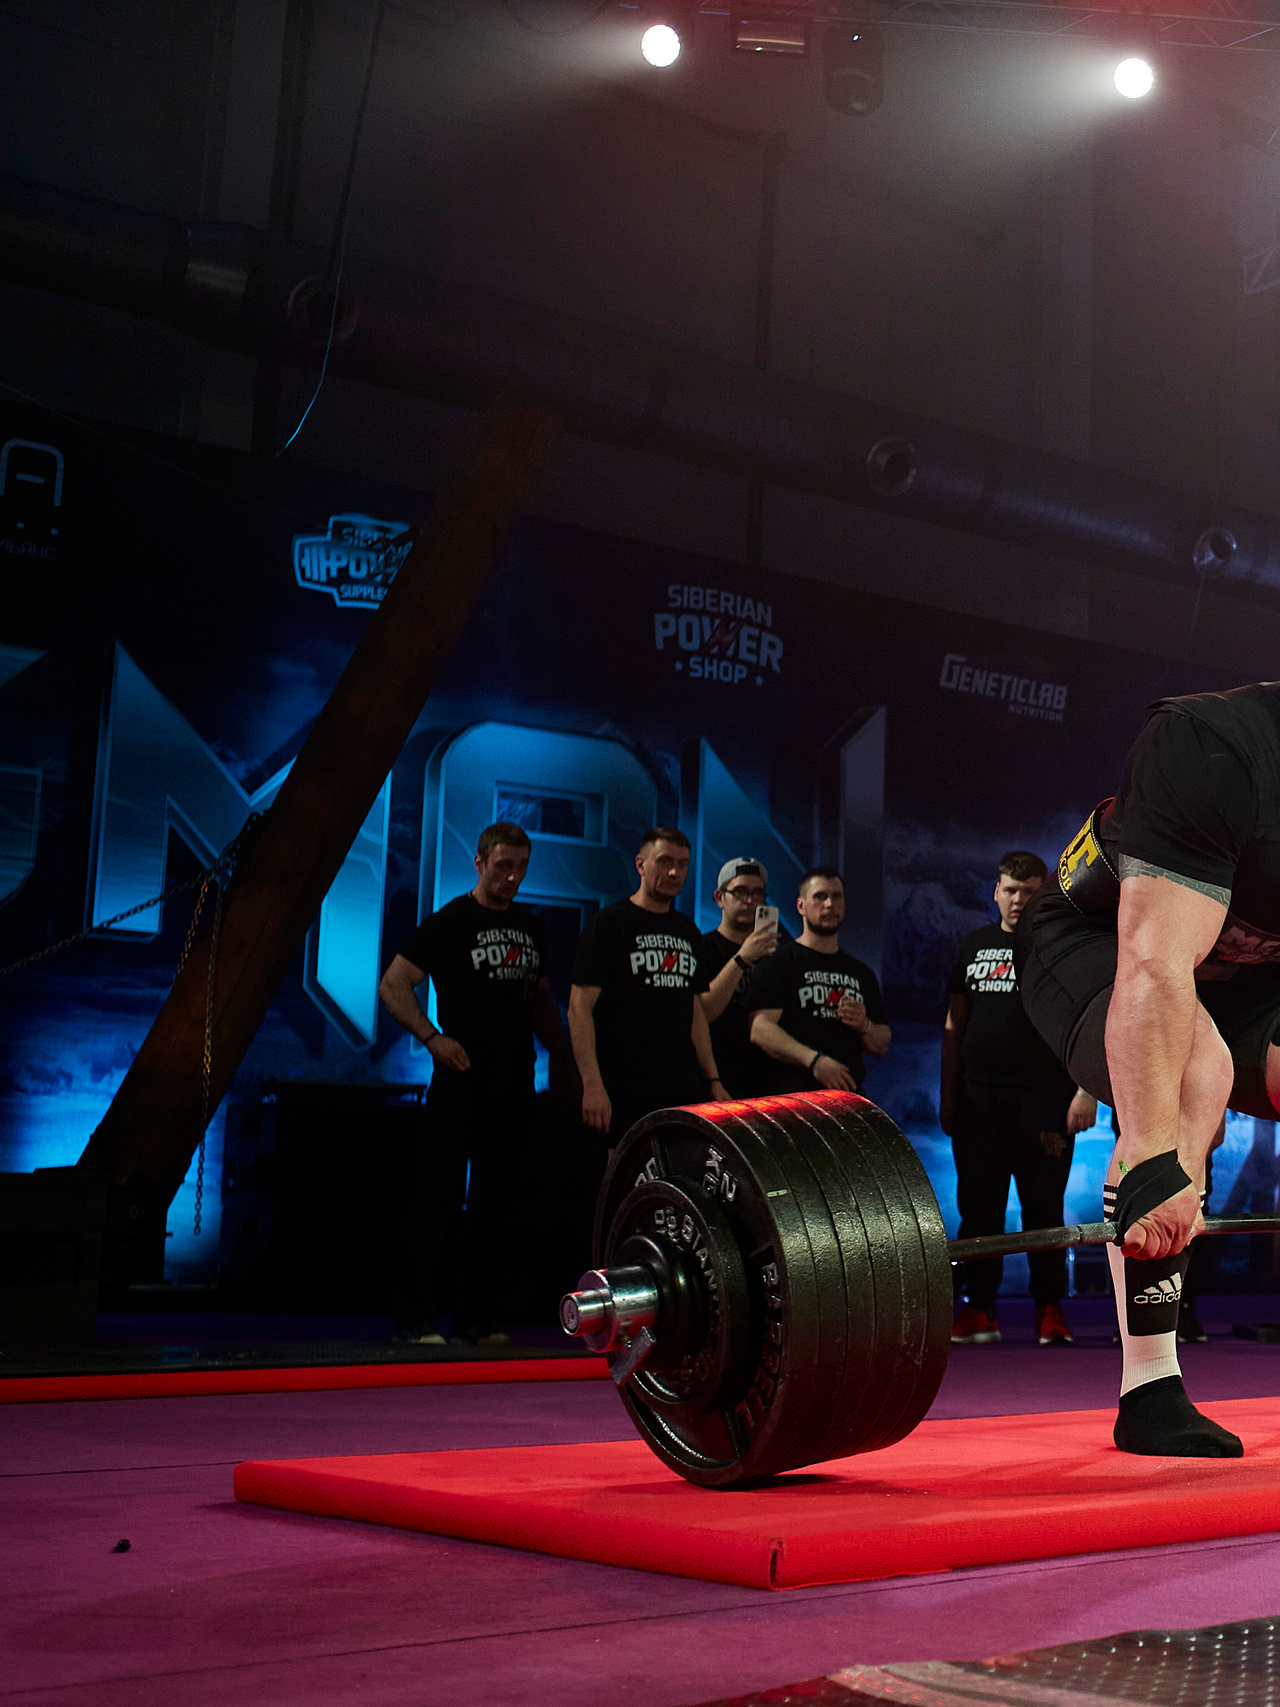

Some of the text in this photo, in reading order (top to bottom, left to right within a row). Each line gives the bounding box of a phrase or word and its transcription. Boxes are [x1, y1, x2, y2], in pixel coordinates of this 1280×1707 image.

[667, 584, 772, 629] SIBERIAN
[654, 612, 783, 674] POWER
[689, 656, 749, 685] SHOP
[1007, 703, 1064, 721] NUTRITION
[636, 933, 693, 954] SIBERIAN
[630, 949, 698, 978] POWER
[974, 948, 1014, 962] SIBER
[653, 973, 685, 989] SHOW
[804, 970, 860, 991] SIBERIAN
[978, 980, 1016, 993] SHOW
